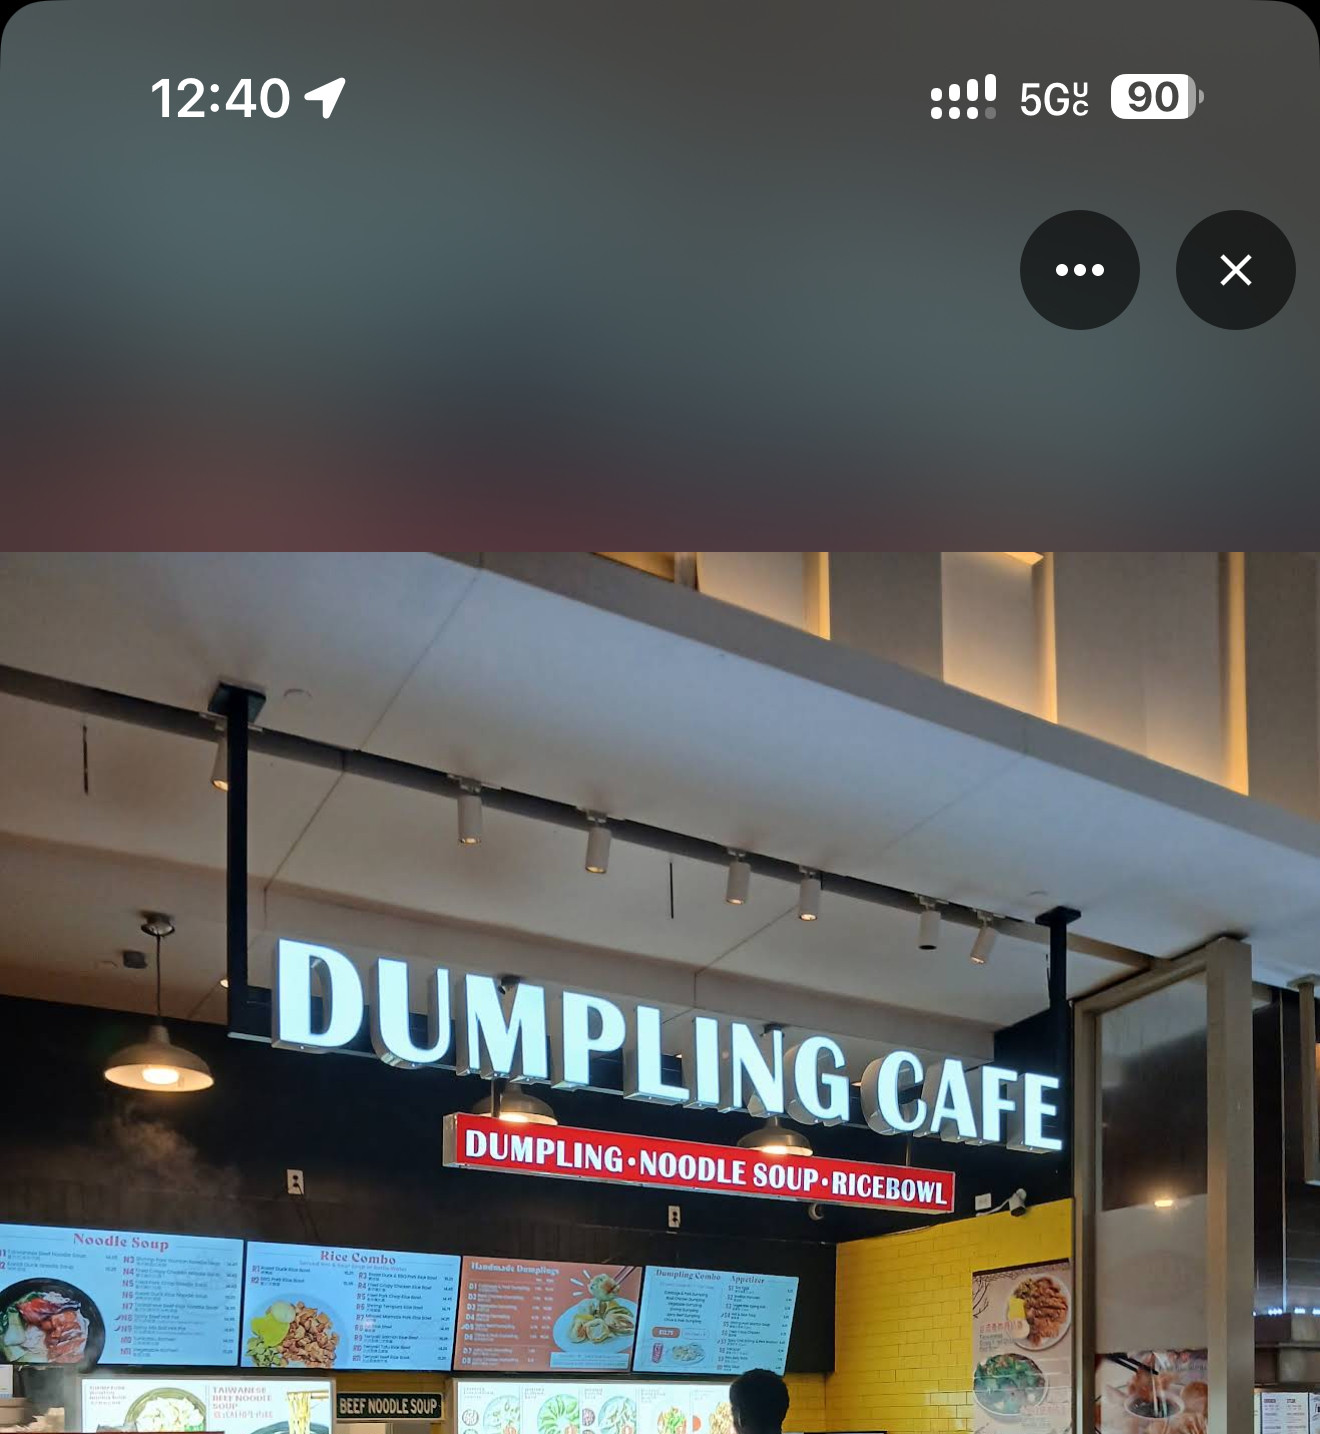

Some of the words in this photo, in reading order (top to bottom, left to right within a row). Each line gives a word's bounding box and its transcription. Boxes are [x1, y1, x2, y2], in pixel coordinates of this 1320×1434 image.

[276, 938, 847, 1120] DUMPLING
[876, 1050, 1064, 1152] CAFE
[465, 1130, 625, 1171] DUMPLING
[637, 1148, 748, 1189] NOODLE
[751, 1162, 821, 1192] SOUP
[830, 1171, 950, 1207] RICEBOWL
[73, 1233, 127, 1248] Noodle
[131, 1237, 169, 1253] Soup
[320, 1250, 348, 1263] Rice
[351, 1252, 396, 1266] Combo
[471, 1262, 515, 1272] Handmade
[517, 1265, 559, 1276] Dumplings
[656, 1269, 693, 1280] Dumpling
[695, 1273, 721, 1281] Combo
[732, 1275, 765, 1284] Appetizer
[339, 1398, 367, 1414] BEEF
[368, 1398, 409, 1414] NOODLE
[410, 1398, 437, 1415] SOUP
